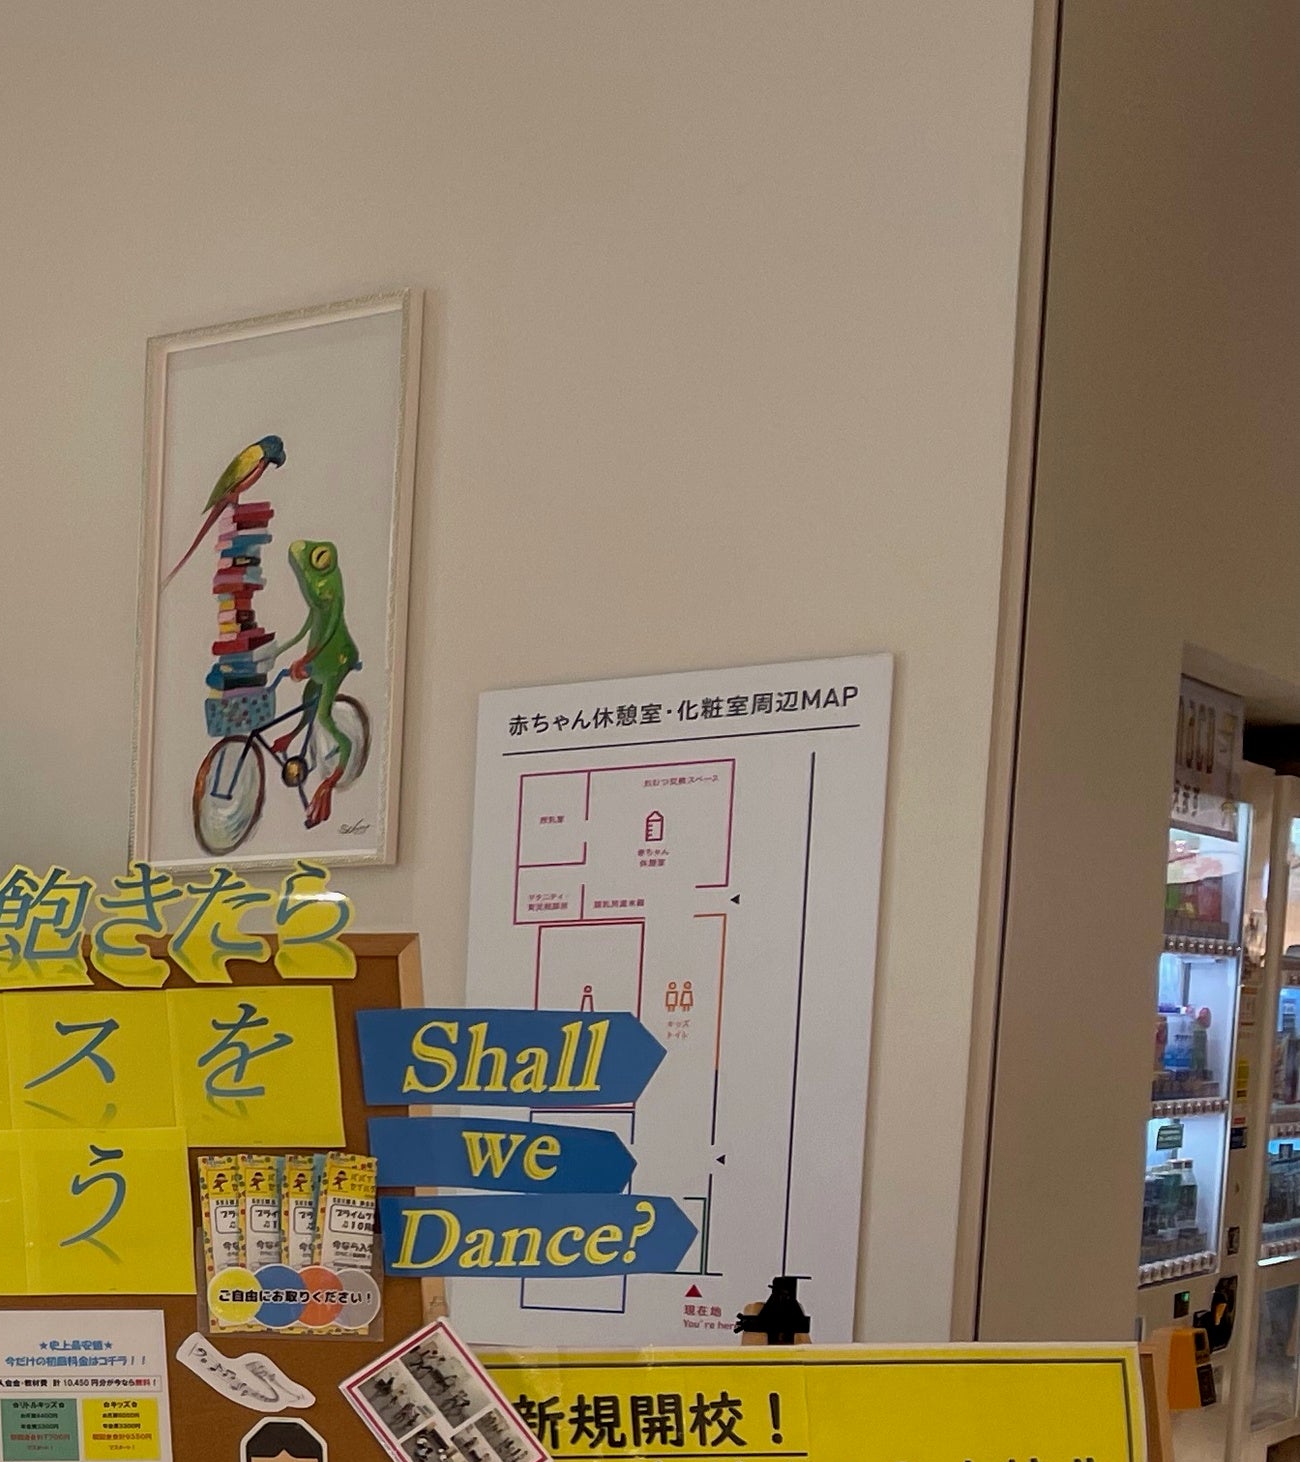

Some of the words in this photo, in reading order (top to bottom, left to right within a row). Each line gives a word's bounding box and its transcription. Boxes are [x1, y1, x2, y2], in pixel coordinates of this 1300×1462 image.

[508, 686, 860, 736] 赤ちゃん休憩室・化粧室周辺MAP
[402, 1019, 610, 1094] Shall
[461, 1131, 562, 1181] we
[391, 1200, 656, 1269] Dance?
[219, 1289, 372, 1304] ご自由にお取りください！
[719, 1319, 740, 1330] her
[512, 1391, 785, 1450] 新規開校！
